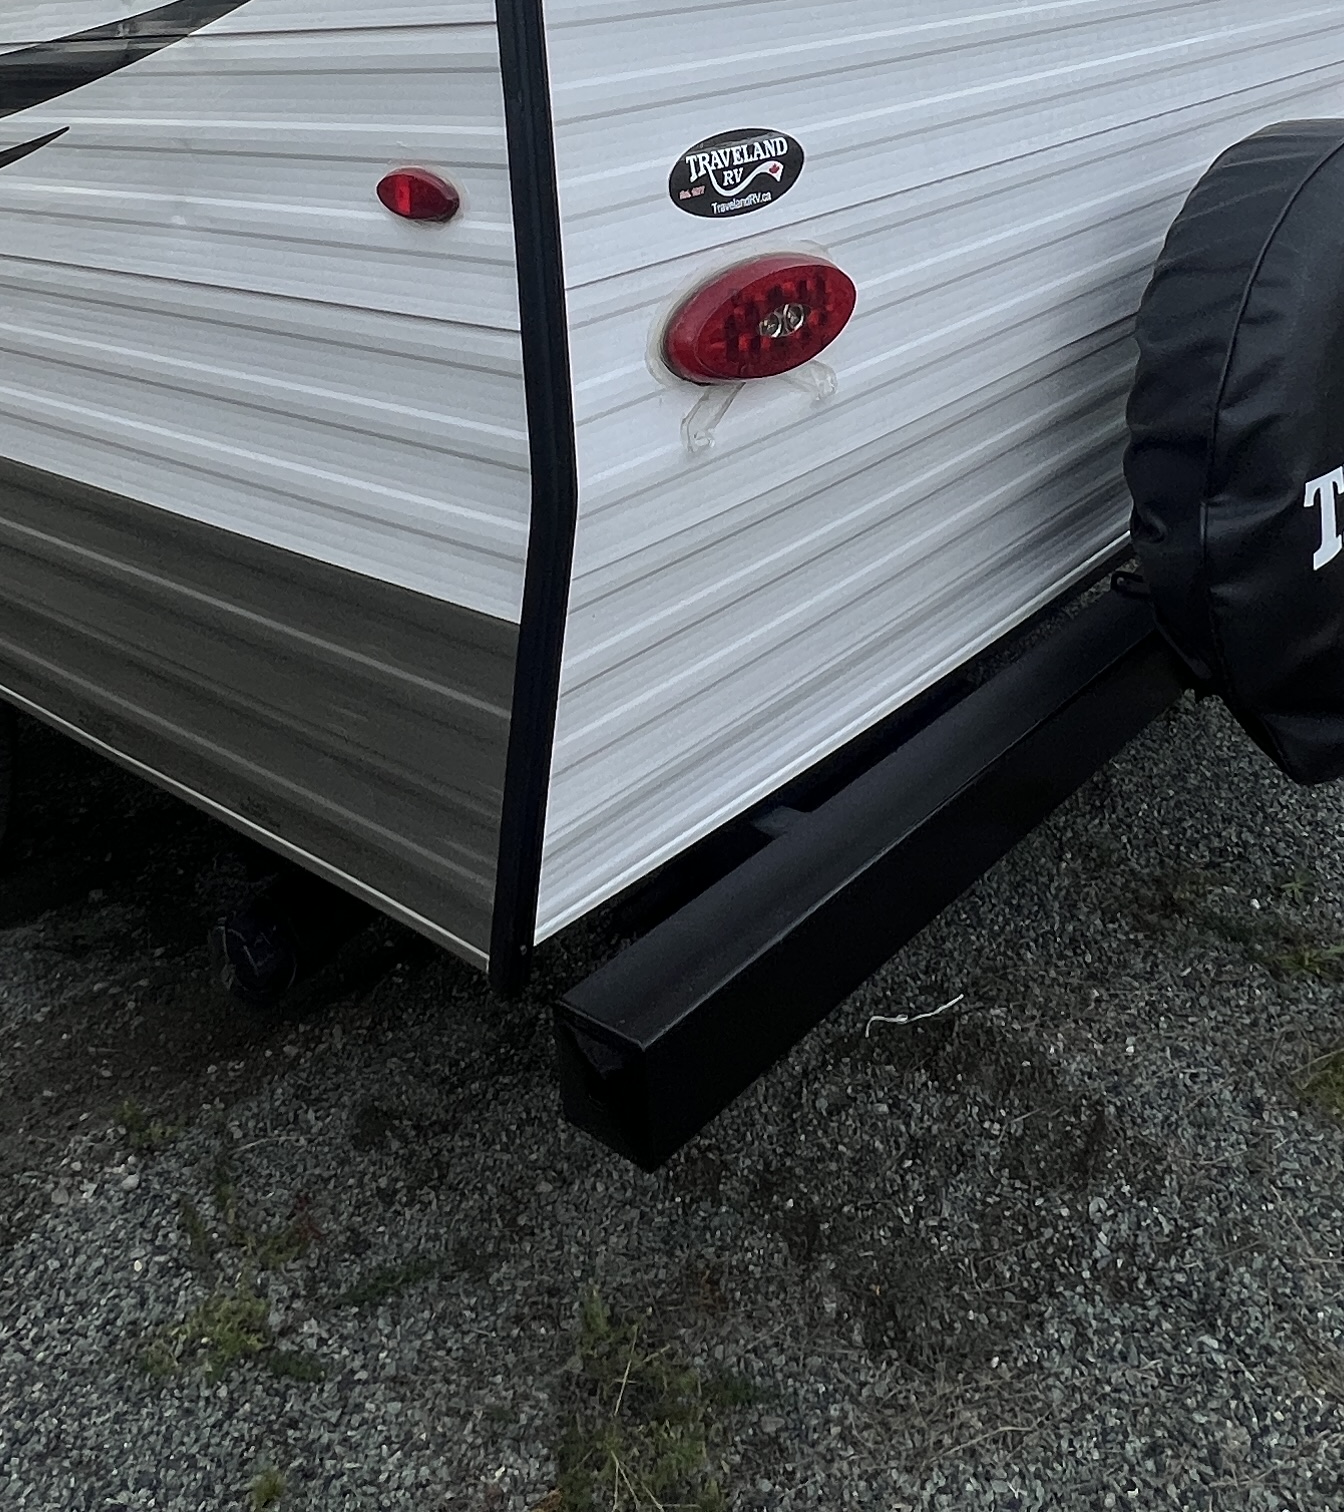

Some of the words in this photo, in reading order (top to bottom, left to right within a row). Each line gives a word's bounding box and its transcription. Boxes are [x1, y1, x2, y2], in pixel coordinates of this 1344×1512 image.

[686, 137, 788, 183] TRAVELAND
[723, 167, 744, 186] RV
[711, 191, 772, 214] TravelandRV.ca
